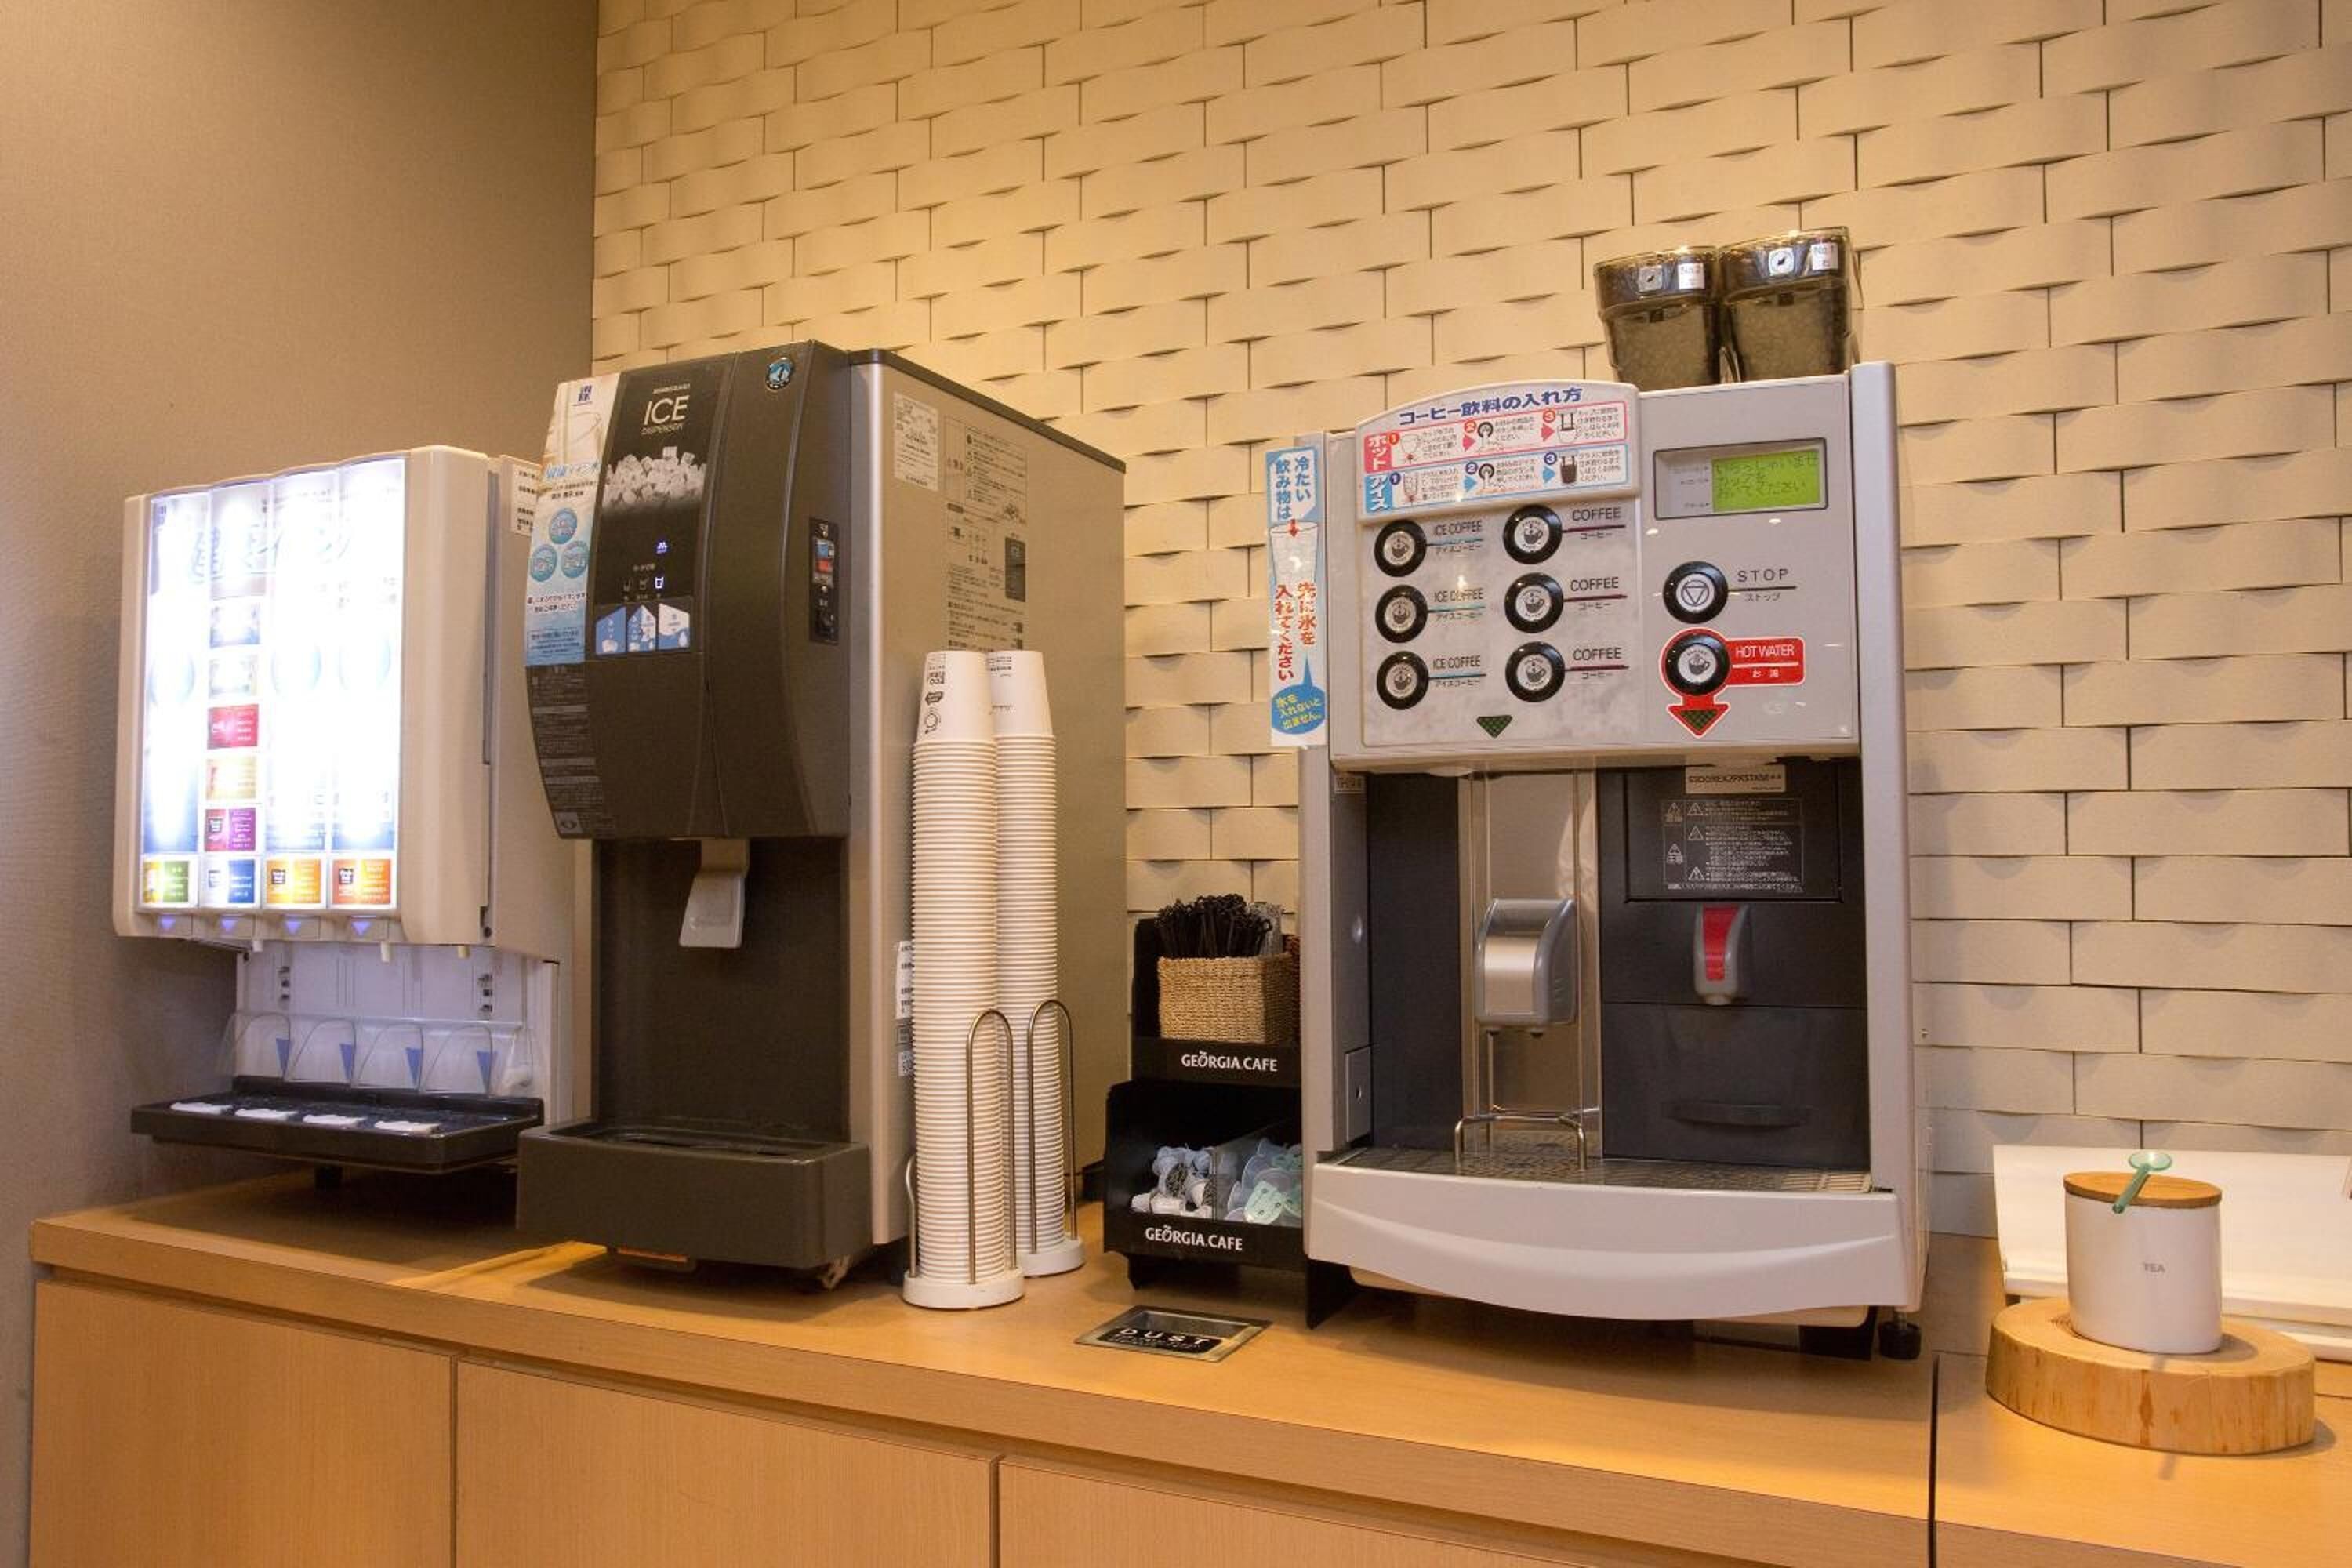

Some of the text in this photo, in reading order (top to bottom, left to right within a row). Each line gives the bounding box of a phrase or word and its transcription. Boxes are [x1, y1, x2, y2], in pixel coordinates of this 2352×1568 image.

[643, 394, 690, 425] ICE
[1399, 387, 1582, 426] コーヒー飲料の入れ方
[1367, 436, 1388, 471] ホット
[1294, 456, 1312, 502] 冷たい
[1276, 459, 1292, 519] 飲み物は
[1370, 475, 1389, 510] アイス
[1572, 507, 1621, 521] COFFEE
[1433, 520, 1483, 536] ICE COFFEE
[1737, 568, 1789, 583] STOP
[1570, 577, 1620, 591] COFFEE
[1434, 590, 1449, 602] ICE
[1745, 593, 1781, 601] ストップ
[1298, 583, 1316, 644] 先に氷を
[1275, 583, 1294, 681] 入れてください
[1573, 647, 1622, 661] COFFEE
[1735, 644, 1795, 659] HOT WATER
[1433, 655, 1481, 669] ICE COFFEE
[1243, 1057, 1278, 1072] CAFE
[1208, 1235, 1243, 1251] CAFE
[2142, 1261, 2165, 1273] TEA
[1120, 1327, 1210, 1345] DUST
